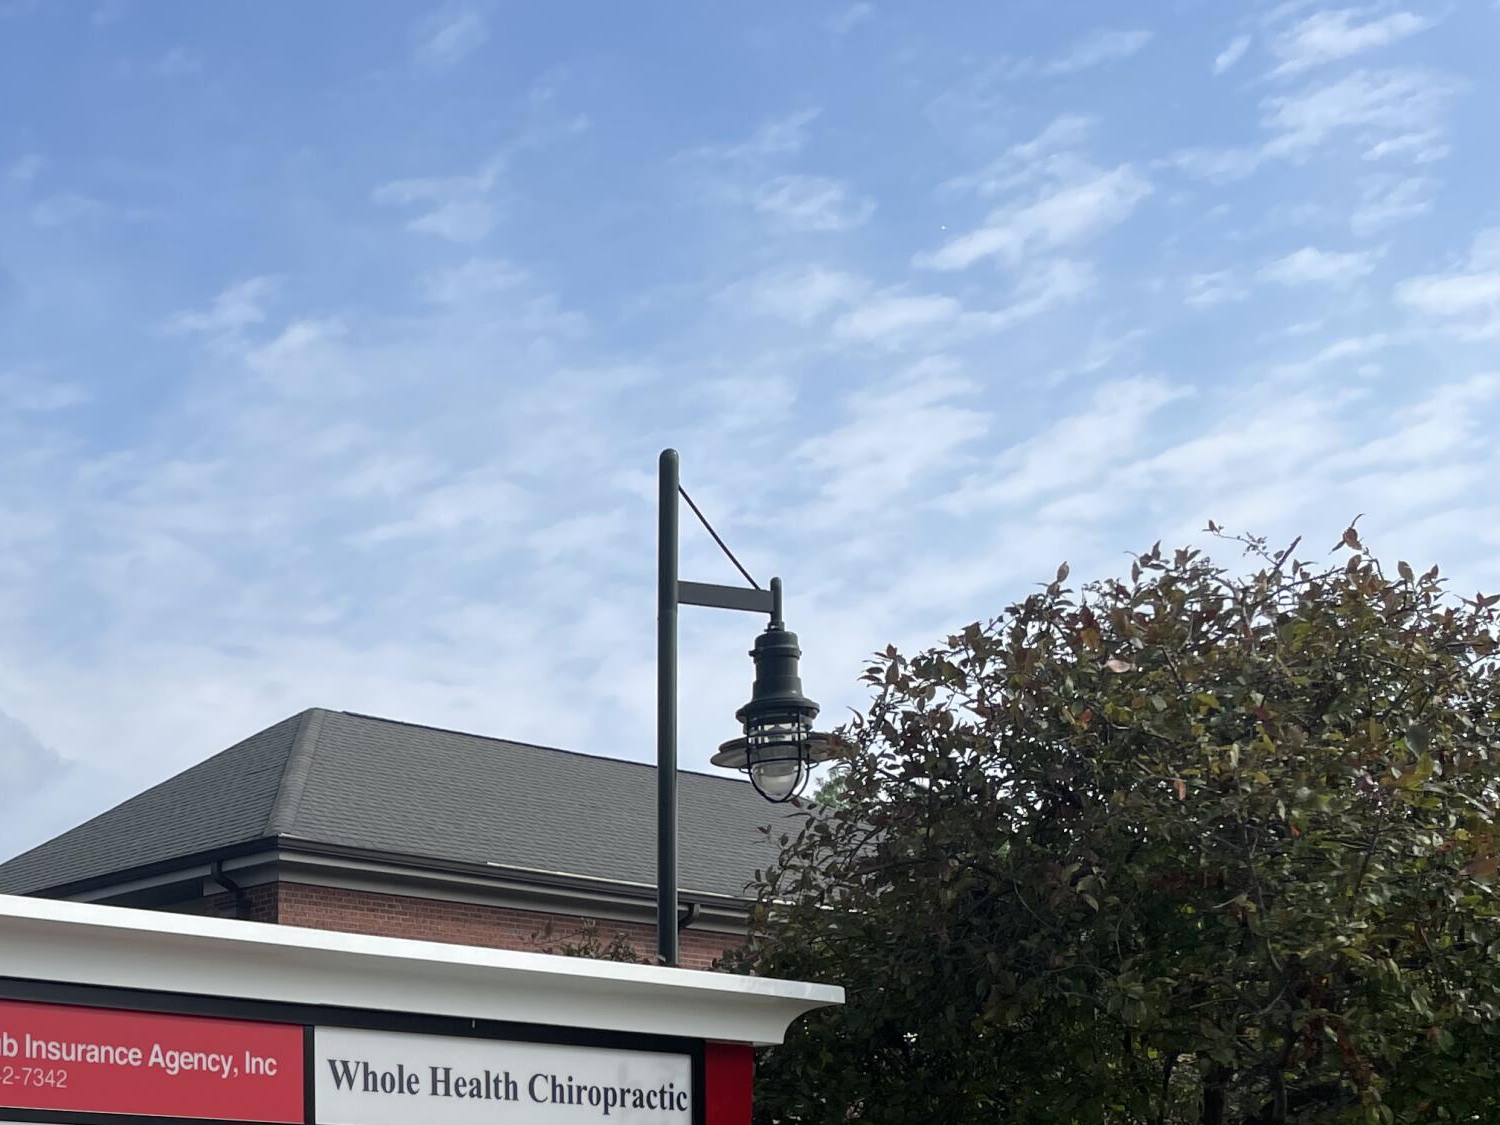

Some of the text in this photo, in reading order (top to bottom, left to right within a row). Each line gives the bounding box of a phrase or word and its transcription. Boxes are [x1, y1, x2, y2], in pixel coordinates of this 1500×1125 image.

[25, 1033, 142, 1068] Insurance
[148, 1044, 239, 1079] Agency,
[244, 1051, 278, 1077] Inc
[327, 1058, 689, 1116] Whole Health Chiropractic
